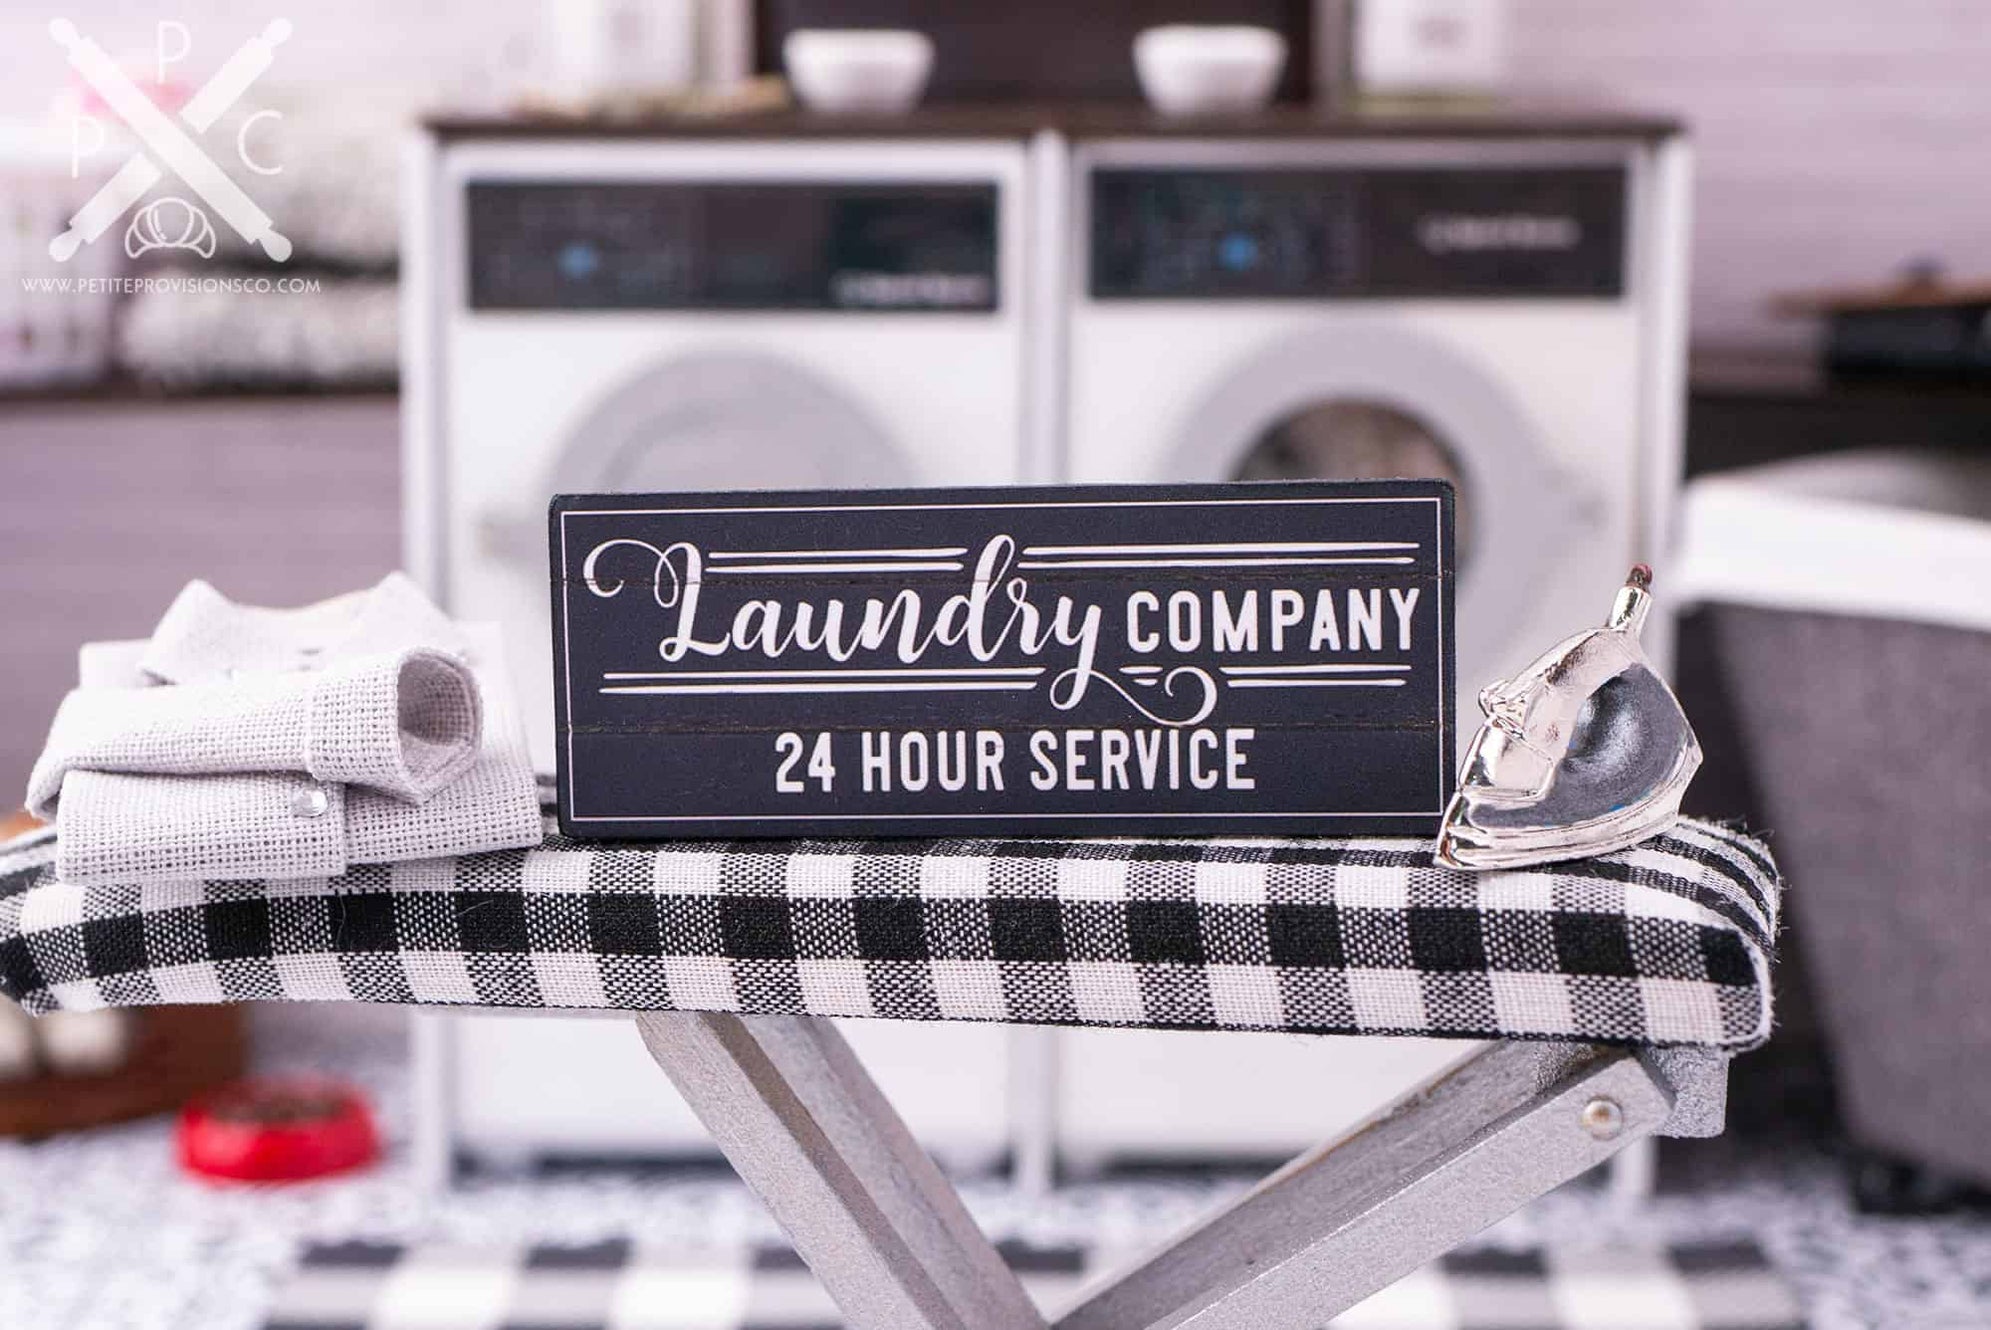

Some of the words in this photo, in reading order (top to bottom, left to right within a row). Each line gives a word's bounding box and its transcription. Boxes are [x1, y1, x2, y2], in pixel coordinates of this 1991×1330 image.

[583, 533, 1217, 727] Laundry
[1125, 588, 1421, 654] COMPANY
[774, 733, 837, 793] 24
[862, 731, 1005, 791] HOUR
[1029, 727, 1256, 791] SERVICE
